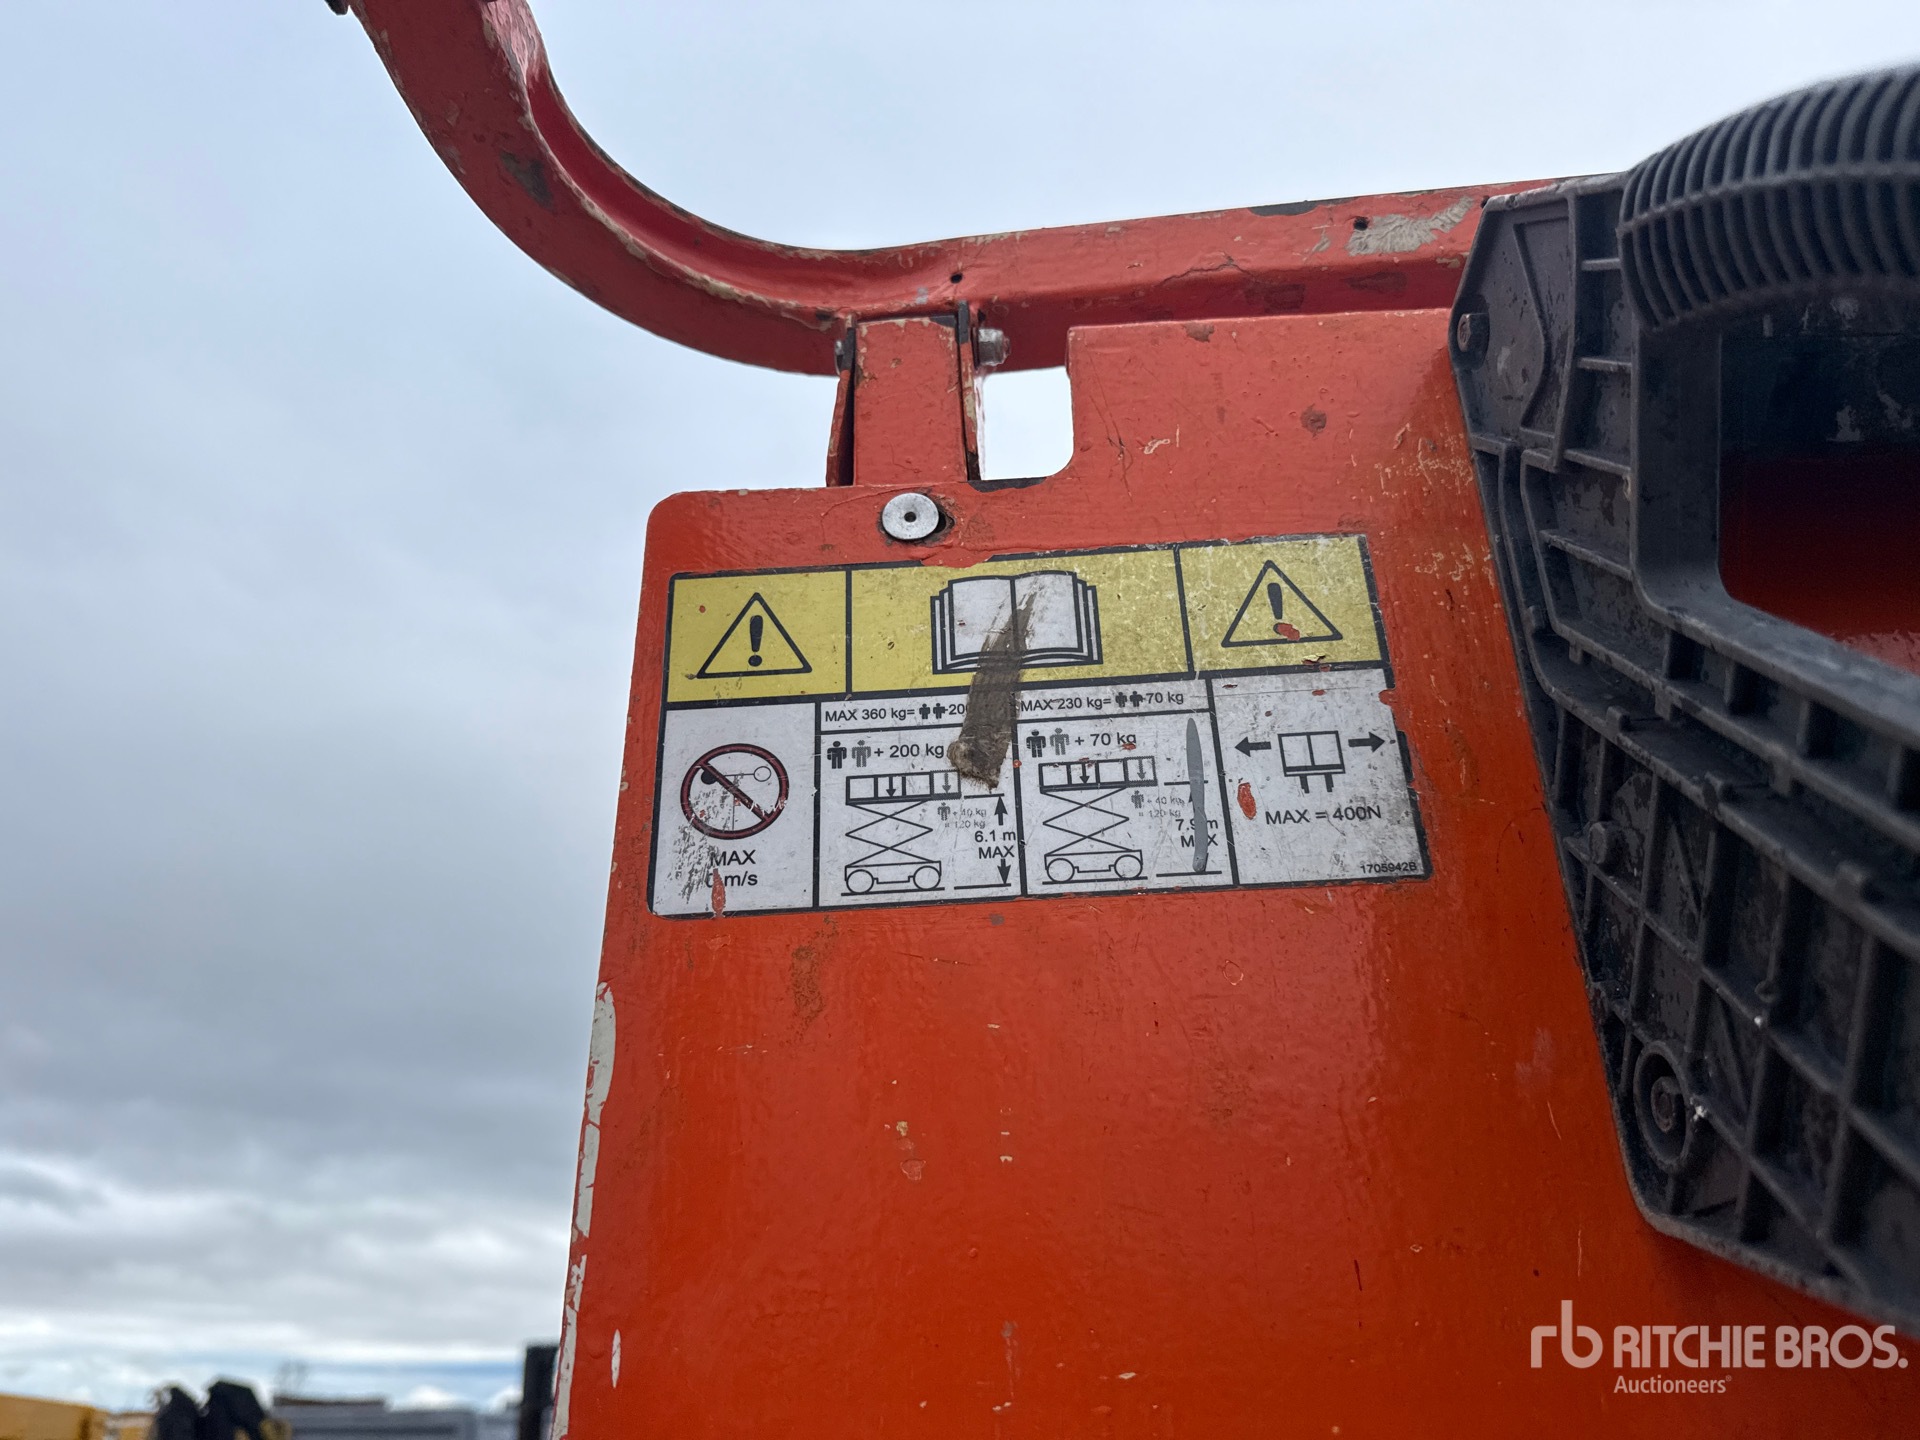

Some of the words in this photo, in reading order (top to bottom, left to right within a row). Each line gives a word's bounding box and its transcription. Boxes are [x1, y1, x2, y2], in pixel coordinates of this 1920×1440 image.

[1020, 698, 1053, 712] MAX
[1057, 697, 1082, 710] 230
[1167, 691, 1184, 705] kg
[825, 709, 857, 722] MAX
[861, 708, 886, 720] 360
[1090, 732, 1111, 747] 70
[889, 744, 920, 758] 200
[926, 743, 944, 759] kg
[1265, 809, 1310, 825] MAX
[1333, 805, 1382, 822] 400N
[974, 830, 996, 843] 6.1
[1002, 831, 1016, 842] m
[1181, 834, 1218, 848] MX
[710, 849, 756, 866] MAX
[978, 845, 1014, 859] MAX
[1360, 861, 1417, 875] 1705942B
[724, 871, 758, 887] m/s
